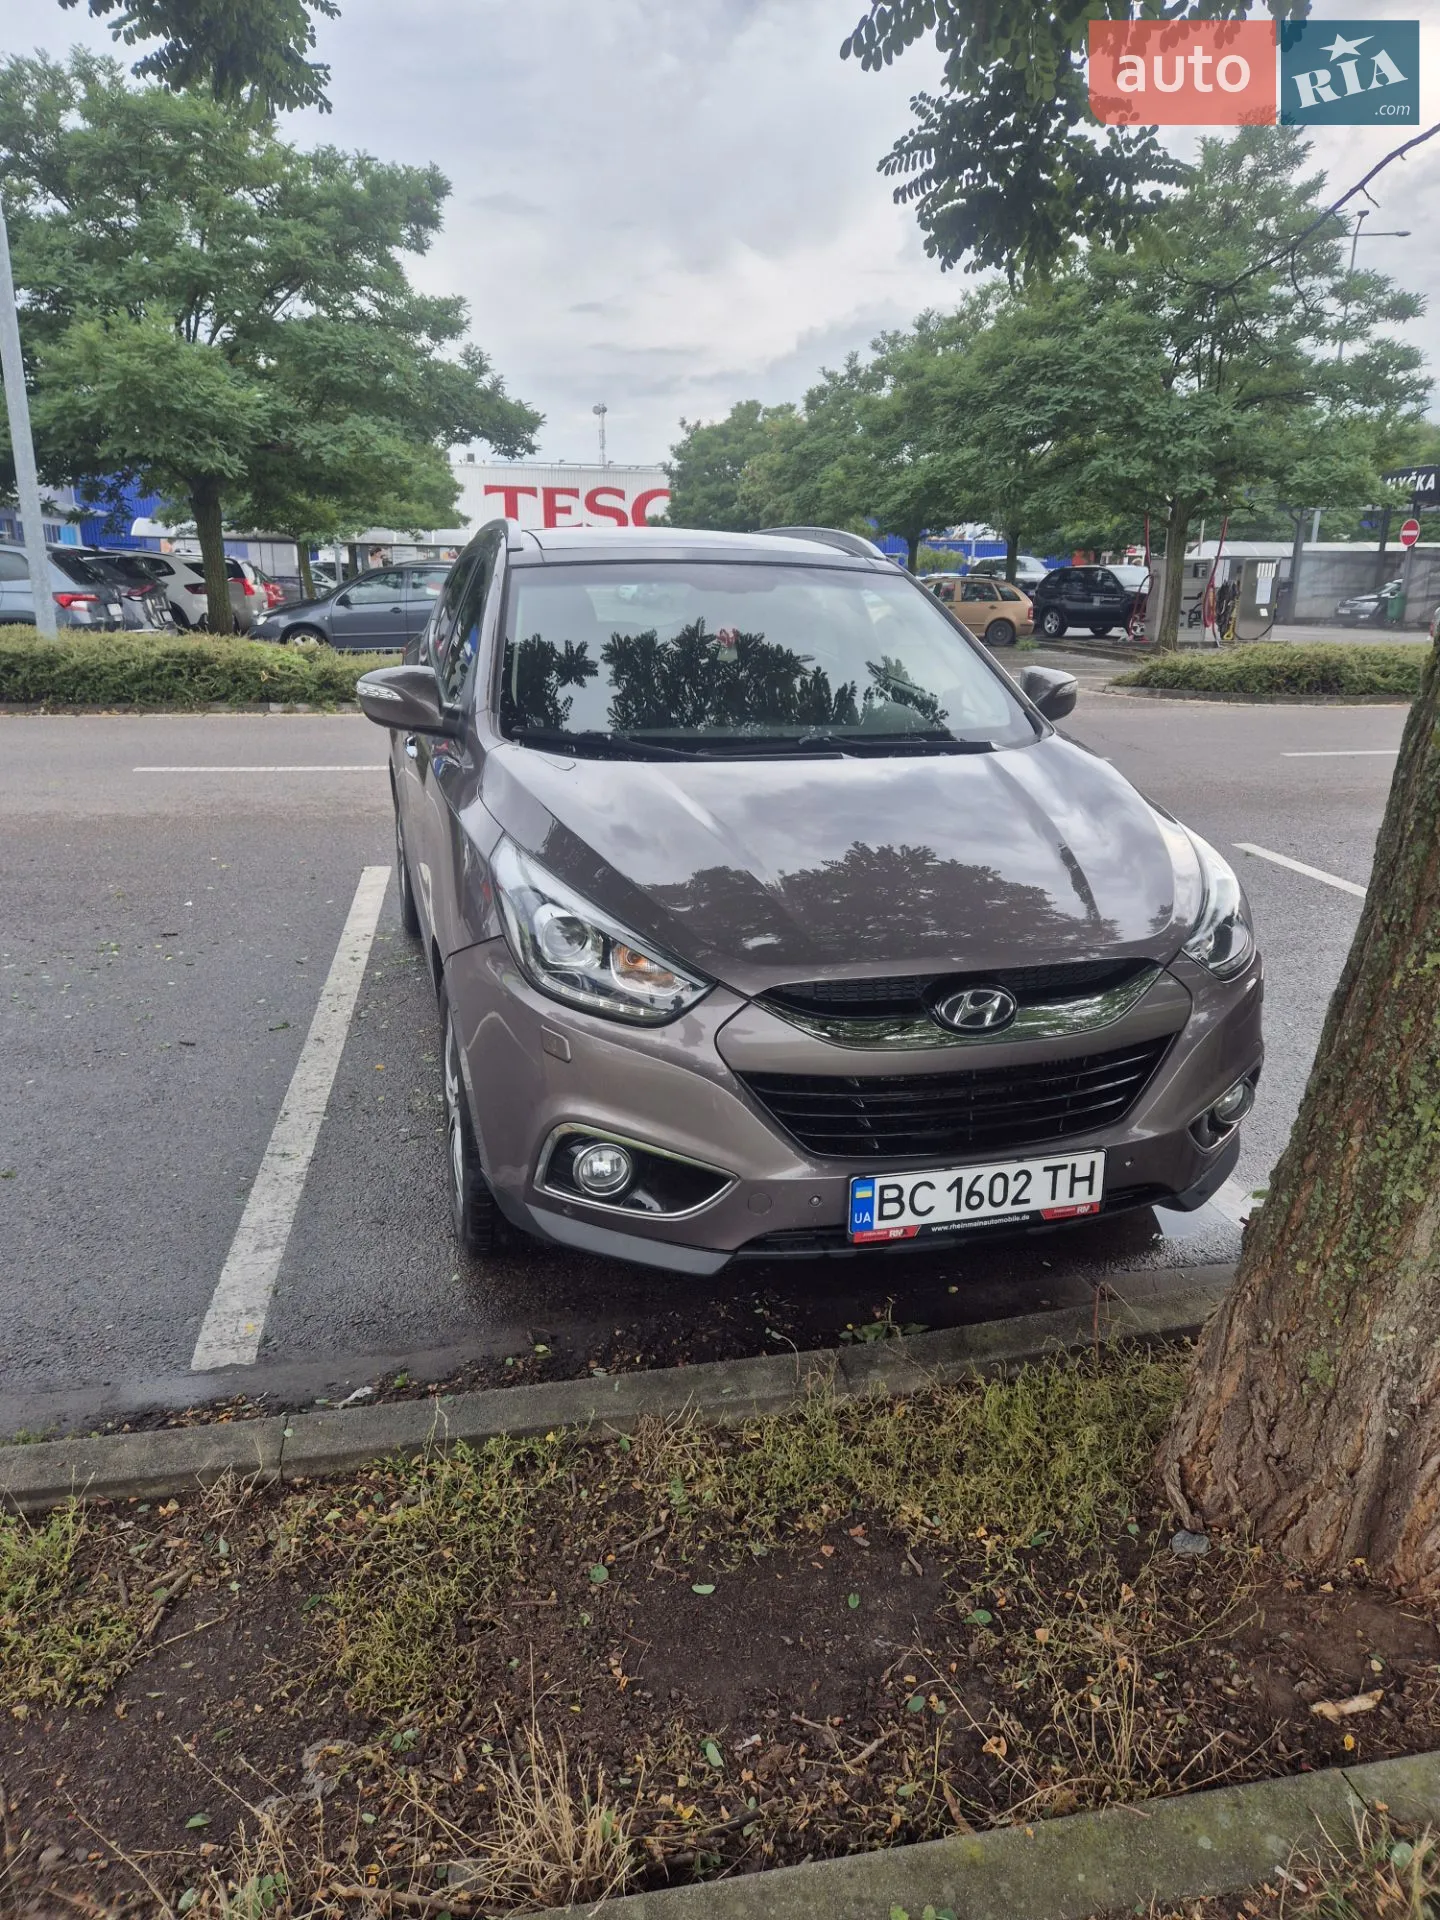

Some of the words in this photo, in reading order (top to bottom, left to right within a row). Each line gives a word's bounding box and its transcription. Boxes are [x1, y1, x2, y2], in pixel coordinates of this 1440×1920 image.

[484, 485, 672, 528] TESC
[878, 1181, 936, 1221] BC
[947, 1169, 1032, 1213] 1602
[1043, 1160, 1095, 1201] TH
[854, 1212, 872, 1224] UA
[931, 1214, 1030, 1232] www.rheinmainautomobile.de
